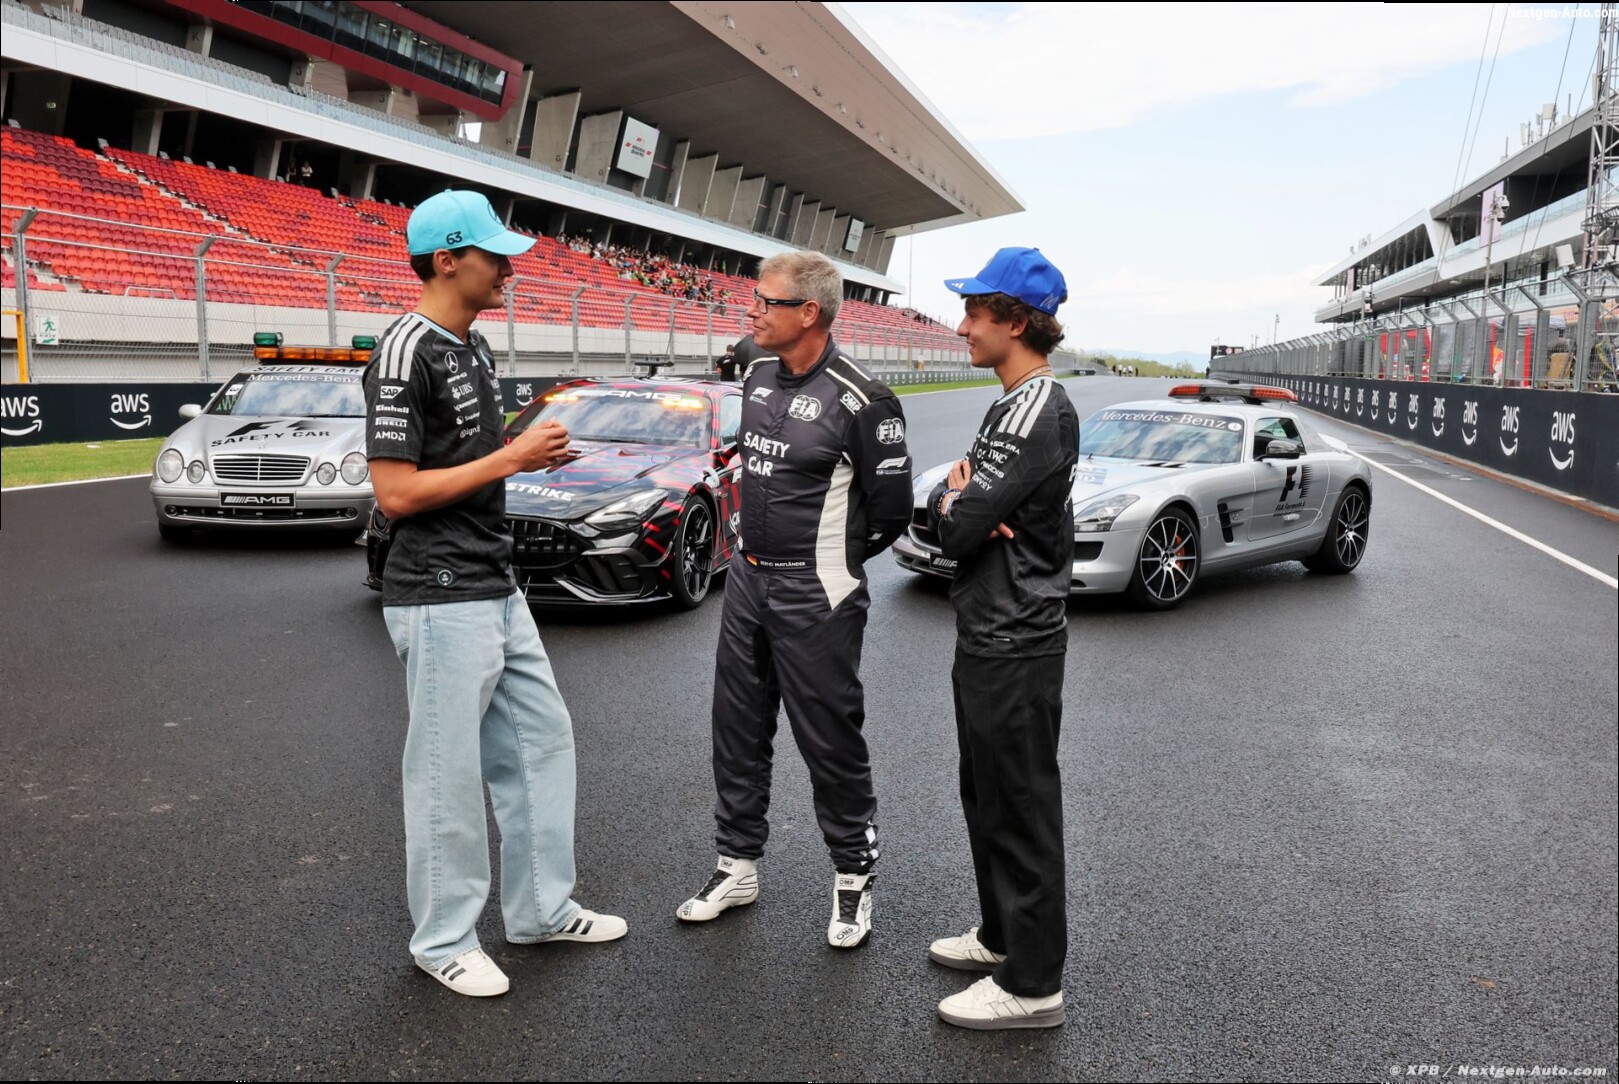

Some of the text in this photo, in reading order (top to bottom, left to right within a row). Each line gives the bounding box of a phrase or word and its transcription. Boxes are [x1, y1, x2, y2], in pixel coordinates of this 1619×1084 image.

[192, 32, 199, 41] K
[446, 231, 462, 245] 63
[247, 374, 361, 384] Mercedes-Benz
[381, 388, 399, 396] SAP
[459, 382, 474, 396] UBS
[516, 383, 532, 396] aws
[605, 390, 682, 400] AMG
[110, 394, 150, 414] aws
[376, 404, 409, 414] Einhell
[788, 397, 818, 418] FIA
[842, 393, 860, 412] OMP
[1408, 393, 1419, 414] aws
[1433, 397, 1446, 420] aws
[1097, 410, 1228, 430] Mercedes-Benz
[1463, 400, 1478, 426] aws
[1501, 405, 1520, 434] aws
[877, 421, 904, 442] FIA
[1551, 410, 1576, 445] aws
[211, 432, 285, 447] SAFETY
[374, 431, 398, 441] AMD
[988, 449, 1008, 464] IWC
[748, 456, 774, 476] CAR
[244, 496, 290, 504] AMG
[836, 927, 854, 940] OMP
